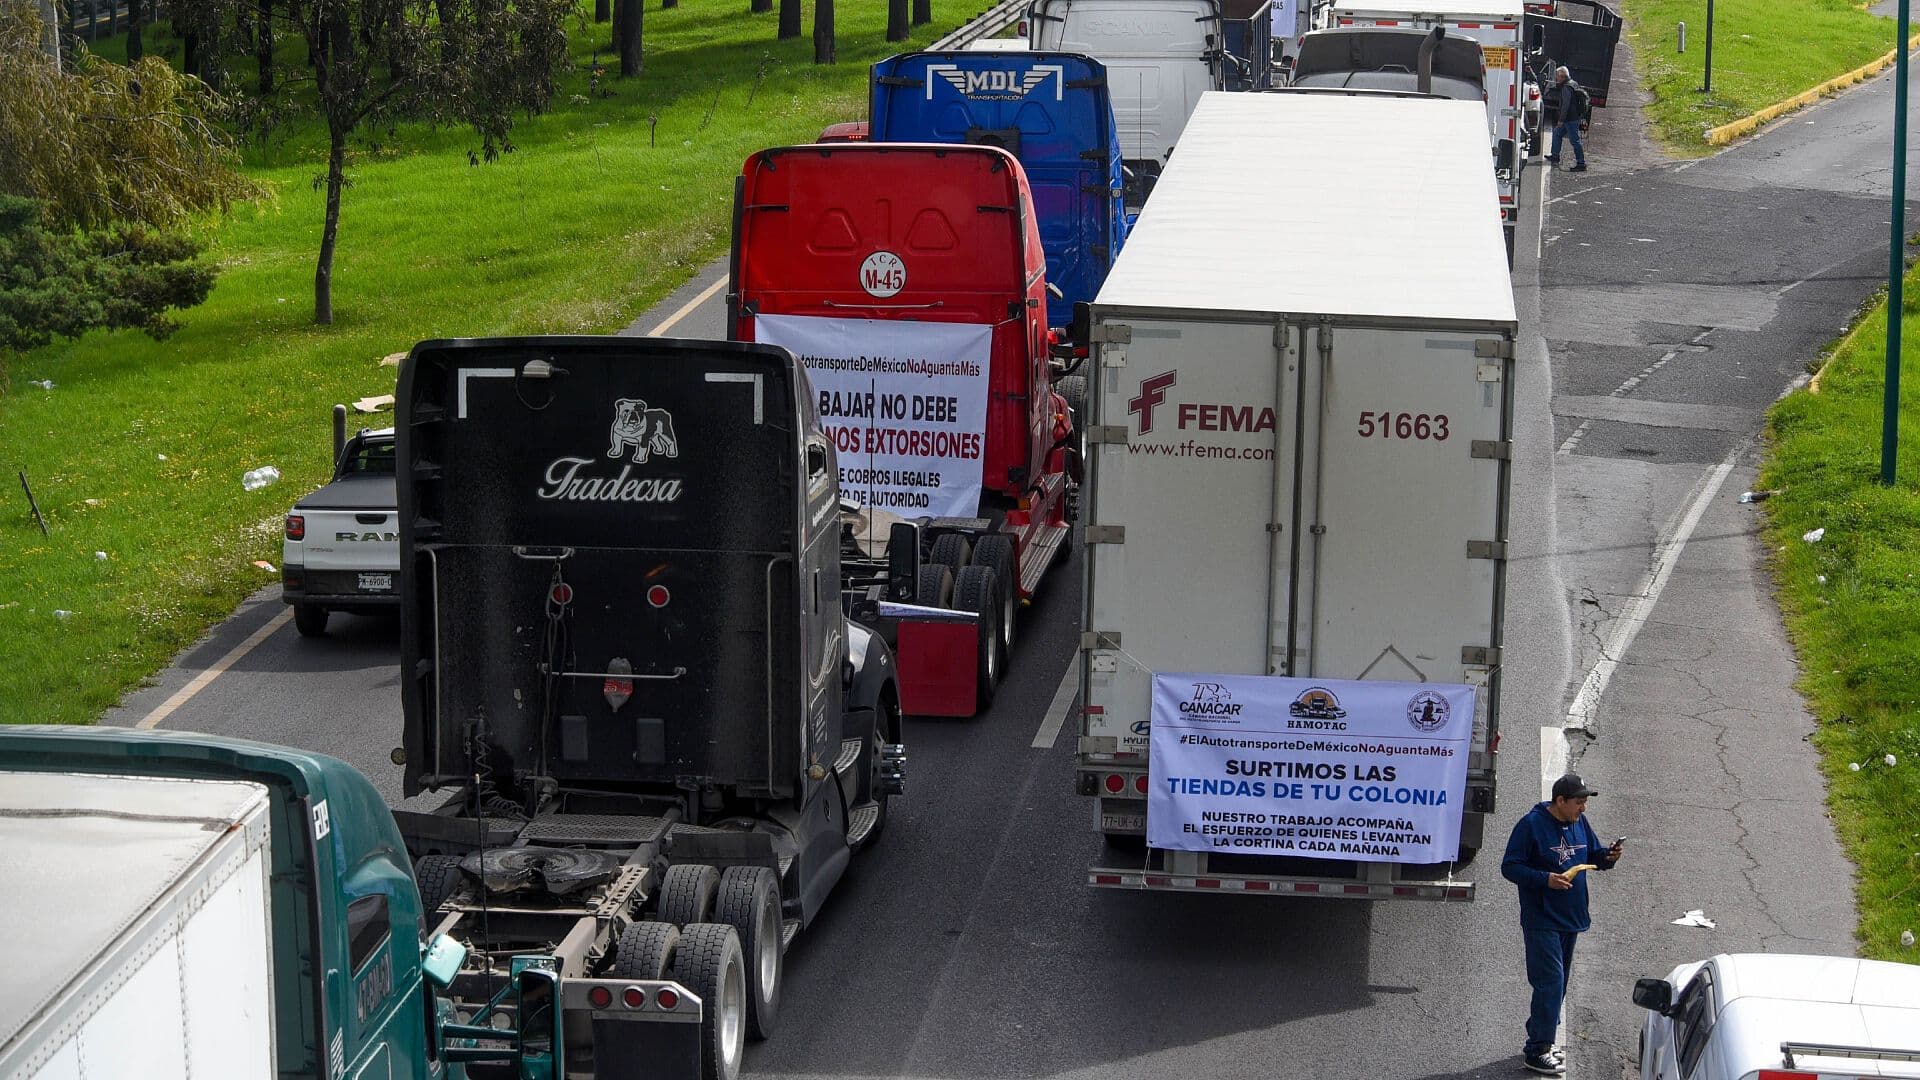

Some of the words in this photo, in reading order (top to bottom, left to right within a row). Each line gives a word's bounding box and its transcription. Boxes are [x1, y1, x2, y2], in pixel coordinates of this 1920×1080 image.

[965, 70, 1023, 95] MDL
[865, 269, 903, 290] M-45
[880, 393, 907, 420] NO
[912, 395, 958, 423] DEBE
[1178, 403, 1277, 434] FEMA
[1357, 411, 1450, 441] 51663
[865, 427, 981, 460] EXTORSIONES
[538, 457, 682, 502] Tradecsa
[847, 469, 891, 486] COBROS
[893, 471, 941, 488] ILEGALES
[869, 490, 929, 508] AUTORIDAD
[335, 532, 400, 542] RAM
[1179, 701, 1241, 716] CANACAR
[1287, 720, 1347, 731] HAMOTAC
[1180, 734, 1454, 757] #ElAutotransporteDeMéxicoNoAguantaMás
[1225, 759, 1347, 780] SURTIMOS
[1354, 764, 1396, 782] LAS
[1167, 778, 1266, 797] TIENDAS
[1273, 782, 1303, 800] DE
[1311, 784, 1341, 801] TU
[1348, 785, 1447, 806] COLONIA
[1202, 811, 1266, 823] NUESTRO
[1270, 814, 1333, 826] TRABAJO
[1337, 816, 1414, 831] ACOMPAÑA
[1183, 823, 1198, 833] EL
[1202, 824, 1273, 836] ESFUERZO
[1276, 827, 1295, 837] DE
[1298, 828, 1358, 841] QUIENES
[1361, 831, 1431, 845] LEVANTAN
[1213, 837, 1230, 847] LA
[1234, 838, 1294, 850] CORTINA
[1298, 840, 1336, 852] CADA
[1340, 841, 1401, 856] MAÑANA
